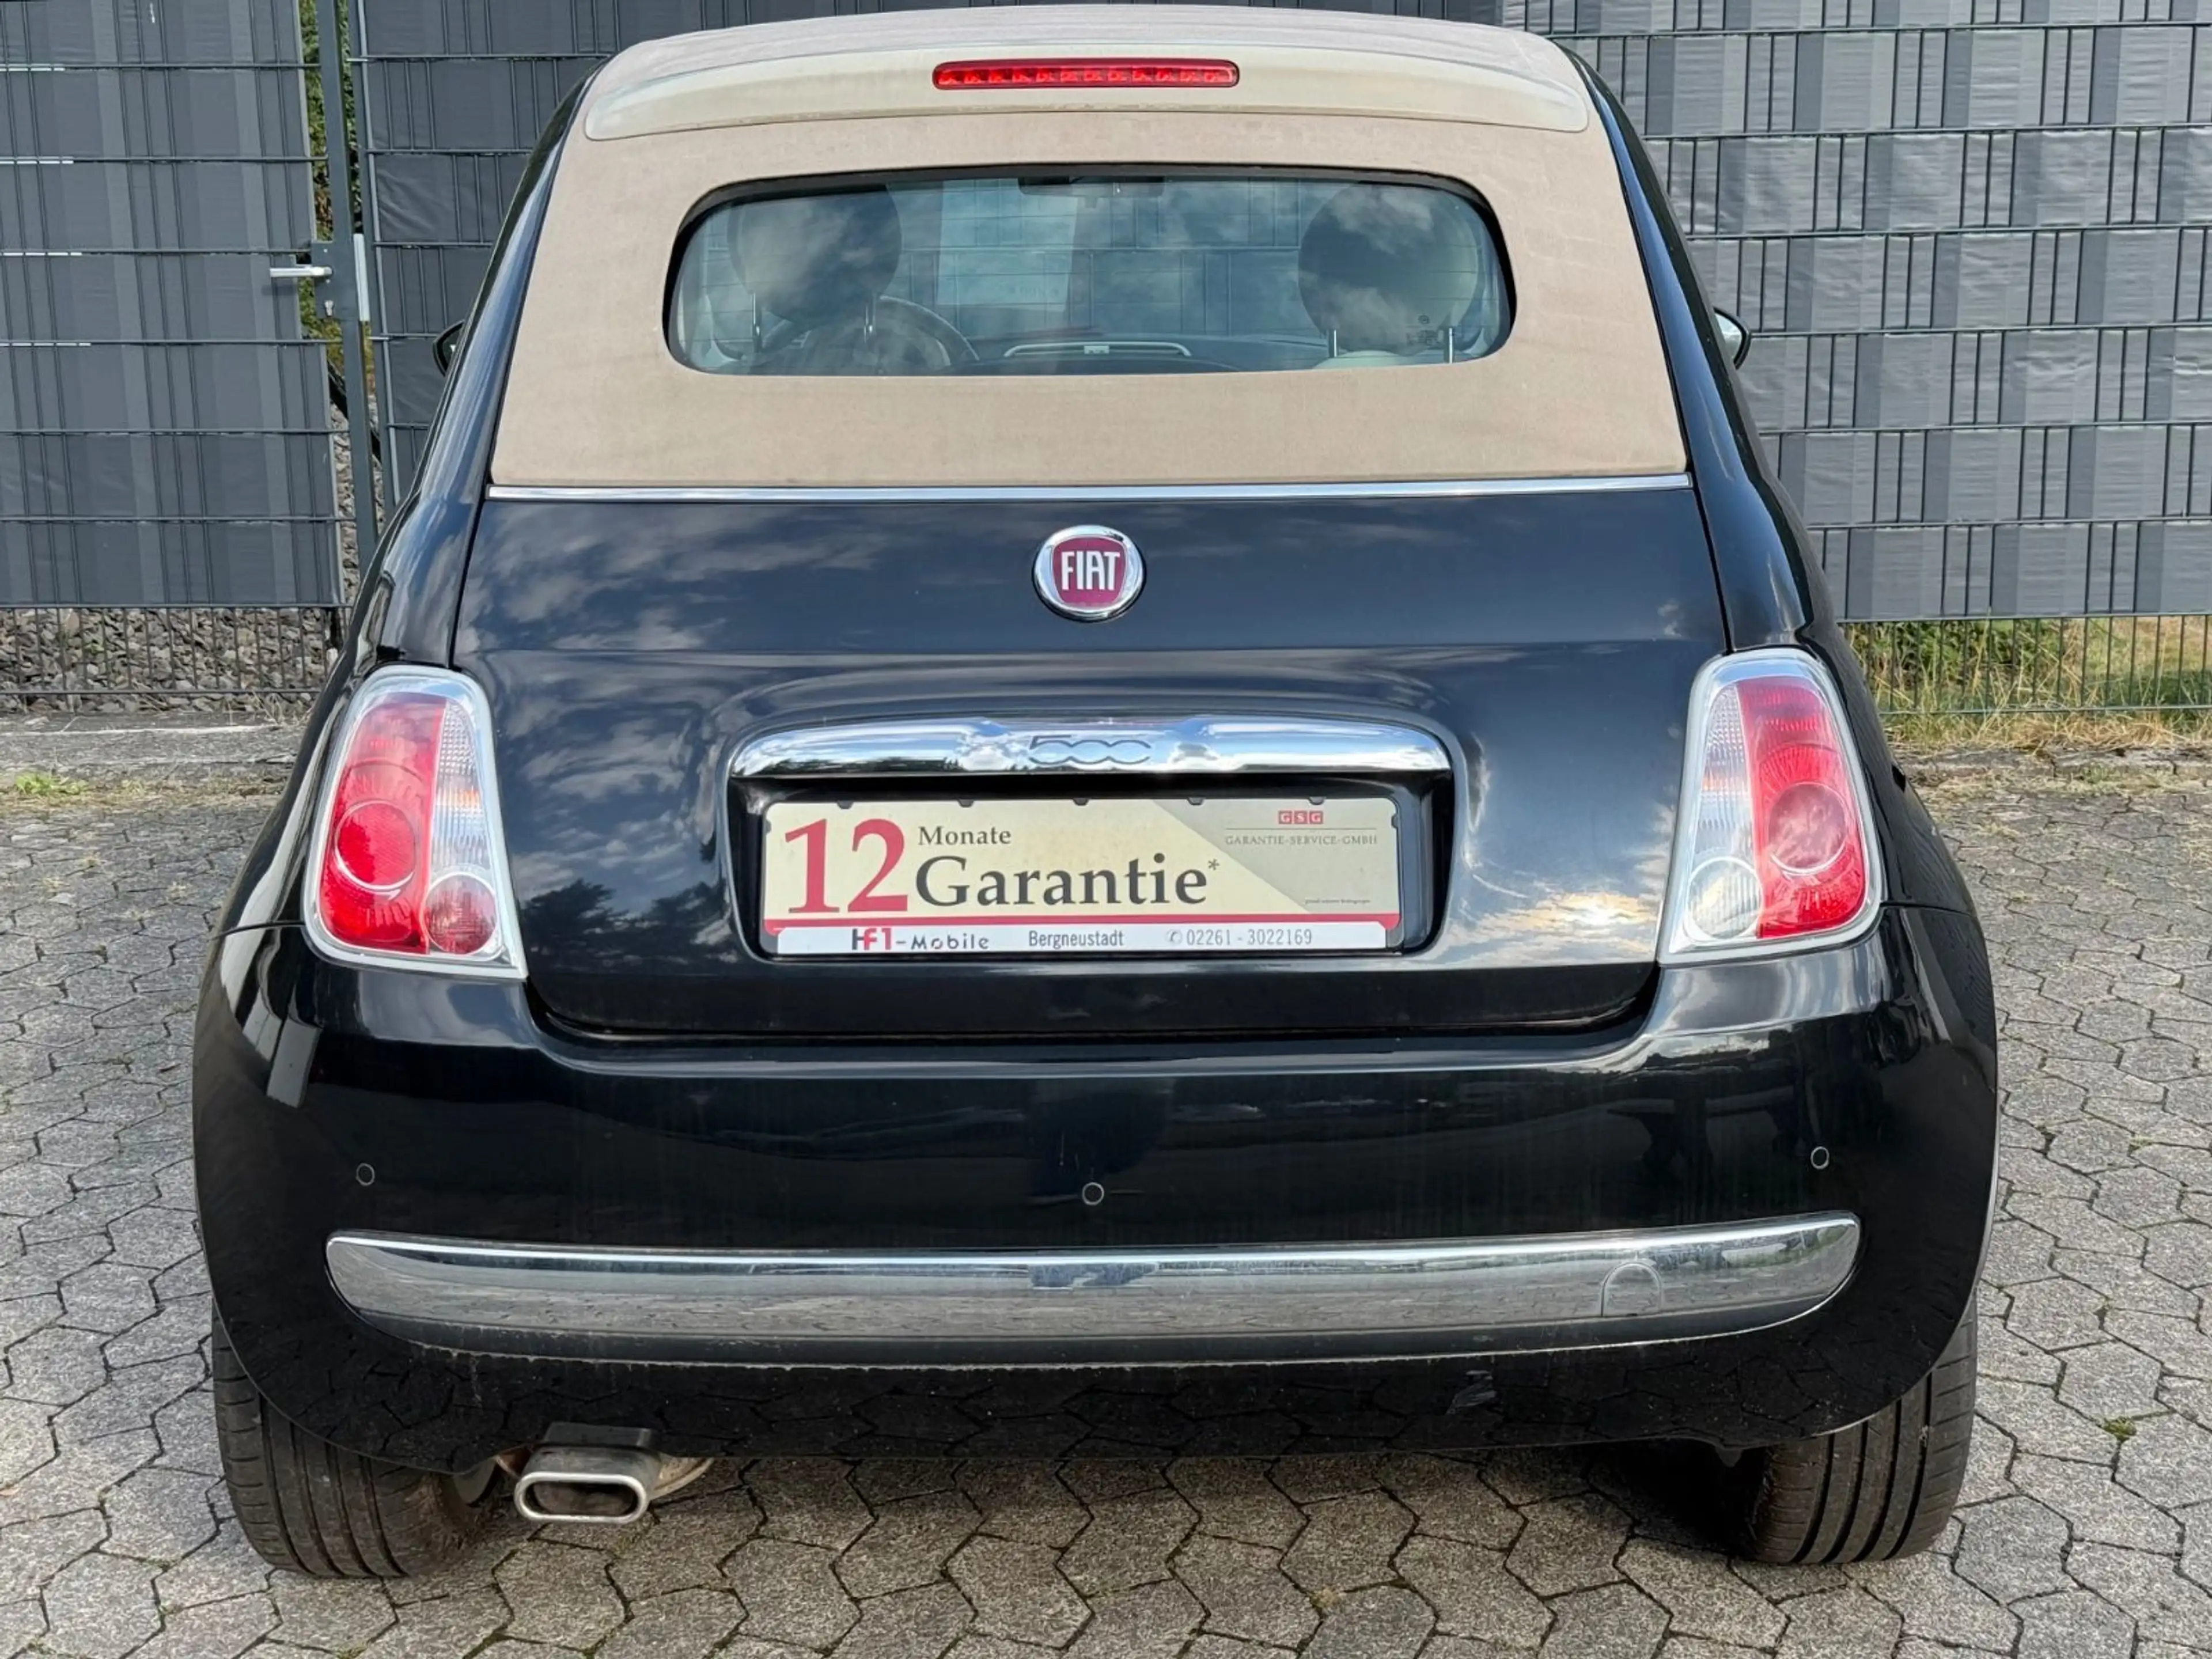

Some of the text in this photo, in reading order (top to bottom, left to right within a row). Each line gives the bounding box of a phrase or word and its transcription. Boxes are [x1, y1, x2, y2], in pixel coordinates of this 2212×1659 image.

[1061, 550, 1121, 590] FIAT
[1029, 734, 1152, 764] 500
[1280, 812, 1323, 823] GSG
[918, 825, 1012, 846] Monate
[785, 818, 908, 914] 12
[1028, 929, 1125, 949] Bergneustadt
[1186, 929, 1232, 945] 02261
[1247, 929, 1312, 945] 3022169
